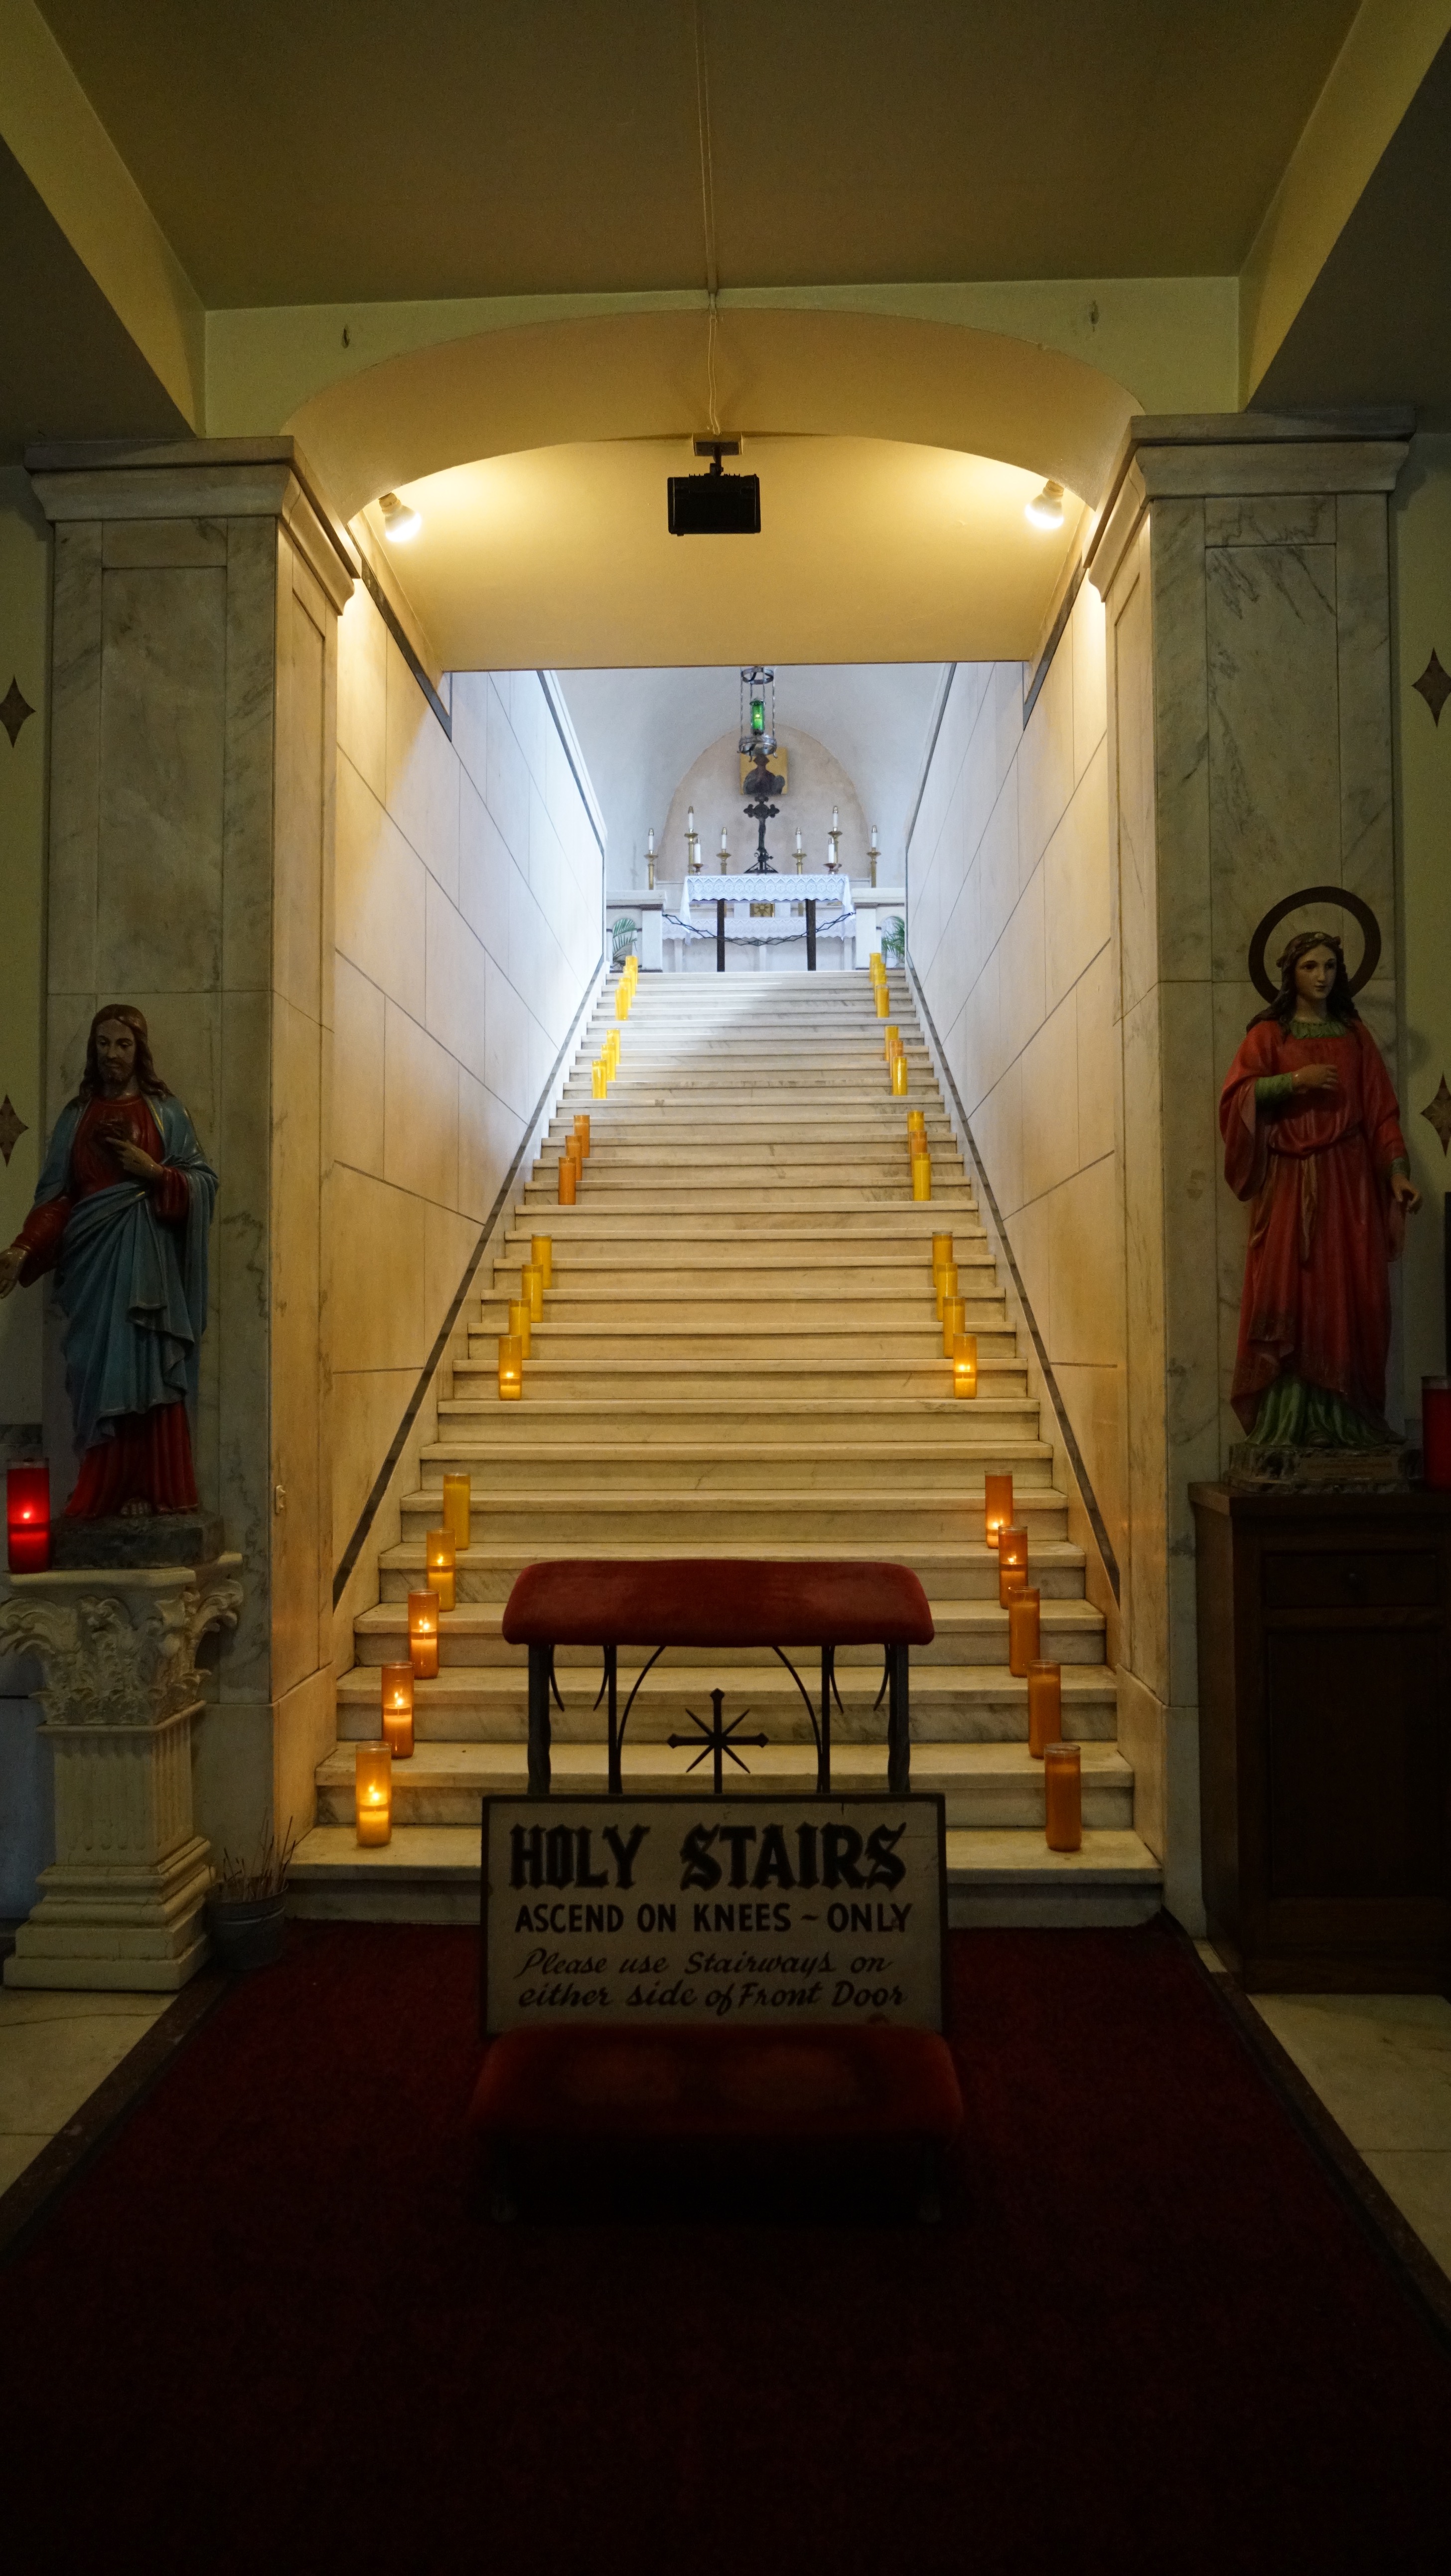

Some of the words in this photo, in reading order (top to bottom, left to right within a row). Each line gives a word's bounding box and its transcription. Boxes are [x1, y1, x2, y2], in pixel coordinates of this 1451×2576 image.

[509, 1822, 650, 1891] HOLY
[680, 1822, 907, 1892] STAIRS
[514, 1904, 623, 1932] ASCEND
[637, 1904, 677, 1932] ON
[694, 1903, 791, 1932] KNEES
[827, 1903, 912, 1932] ONLY
[514, 1947, 607, 1980] Please
[619, 1956, 669, 1974] use
[684, 1950, 836, 1978] Stairways
[851, 1957, 894, 1974] on
[518, 1982, 613, 2007] either
[626, 1980, 696, 2007] side
[706, 1982, 735, 2016] of
[738, 1982, 822, 2007] Front
[831, 1981, 908, 2007] Door
